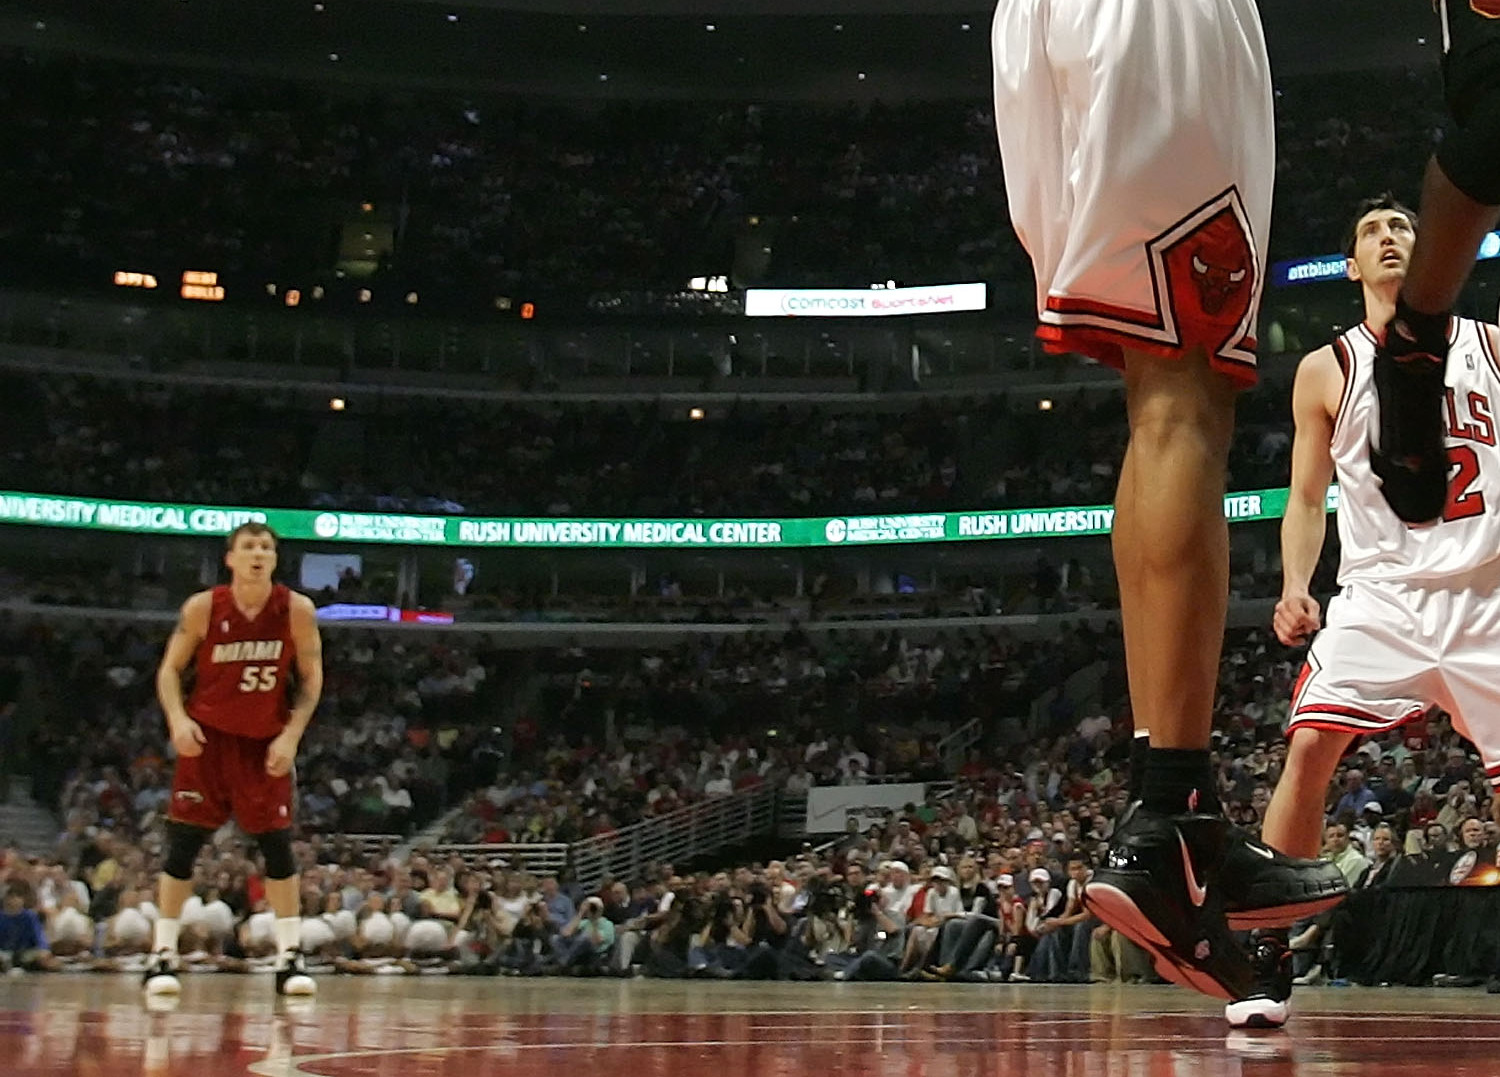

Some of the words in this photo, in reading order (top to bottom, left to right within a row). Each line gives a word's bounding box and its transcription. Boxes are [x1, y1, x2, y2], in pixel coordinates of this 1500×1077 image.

[787, 296, 866, 310] comcast
[0, 495, 97, 523] NIVERSITY
[97, 504, 188, 530] MEDICAL
[959, 514, 1007, 536] RUSH
[1011, 509, 1114, 534] UNIVERSITY
[460, 520, 509, 542] RUSH
[514, 521, 624, 543] UNIVERSITY
[624, 522, 707, 543] MEDICAL
[710, 522, 782, 543] CENTER
[212, 640, 283, 664] MIAMI
[239, 665, 279, 692] 55
